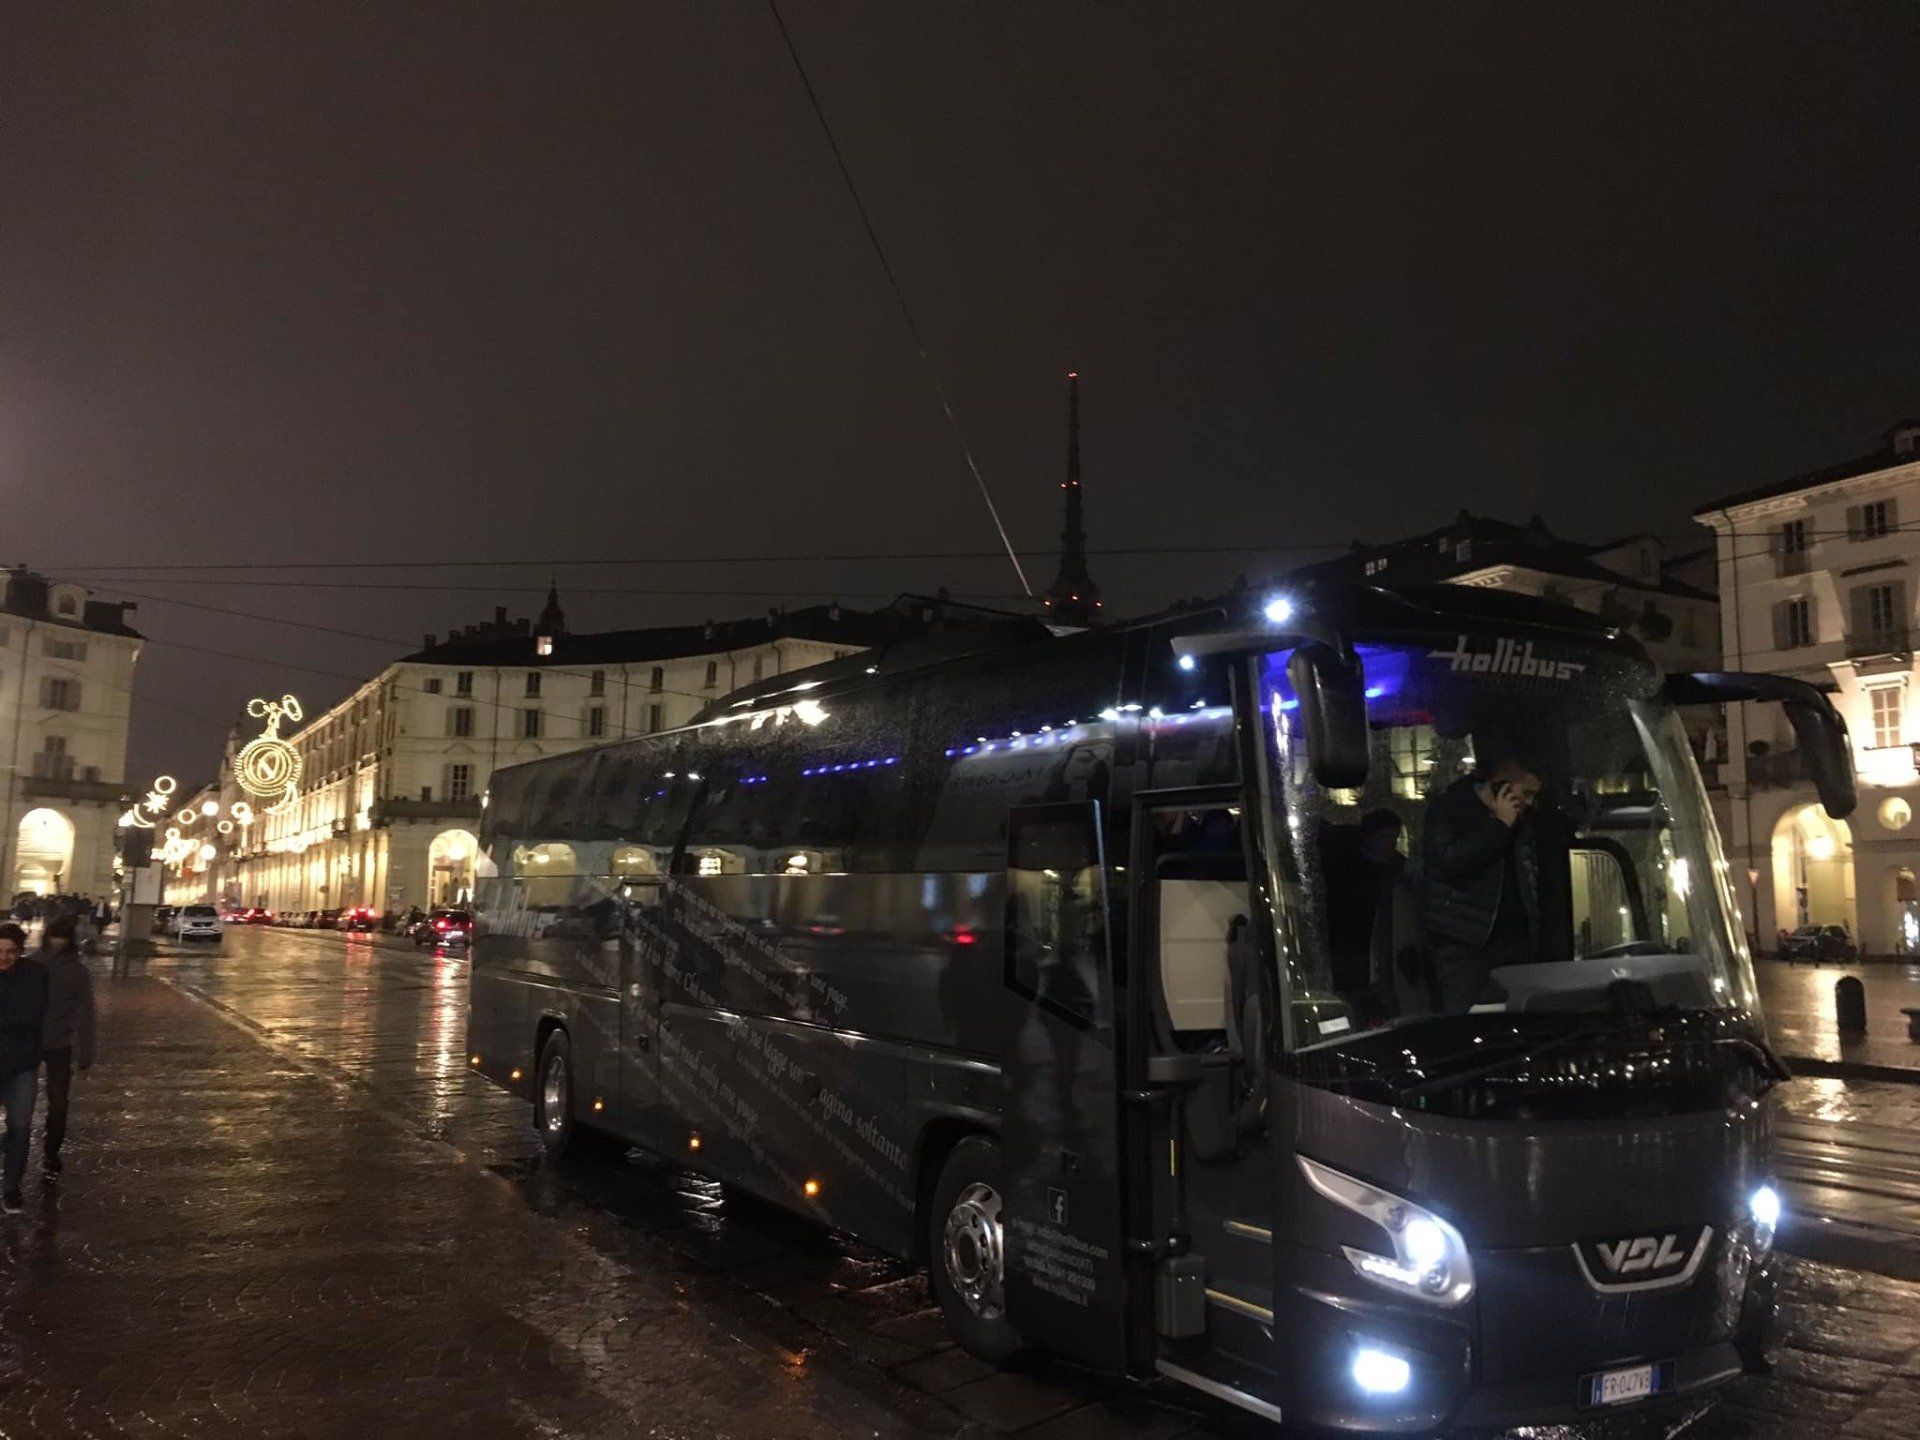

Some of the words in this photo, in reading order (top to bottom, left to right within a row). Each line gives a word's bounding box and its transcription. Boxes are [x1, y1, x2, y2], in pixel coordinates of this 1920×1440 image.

[1426, 634, 1586, 681] hollibus
[855, 1115, 908, 1170] soltanto
[1597, 1234, 1684, 1274] VDL
